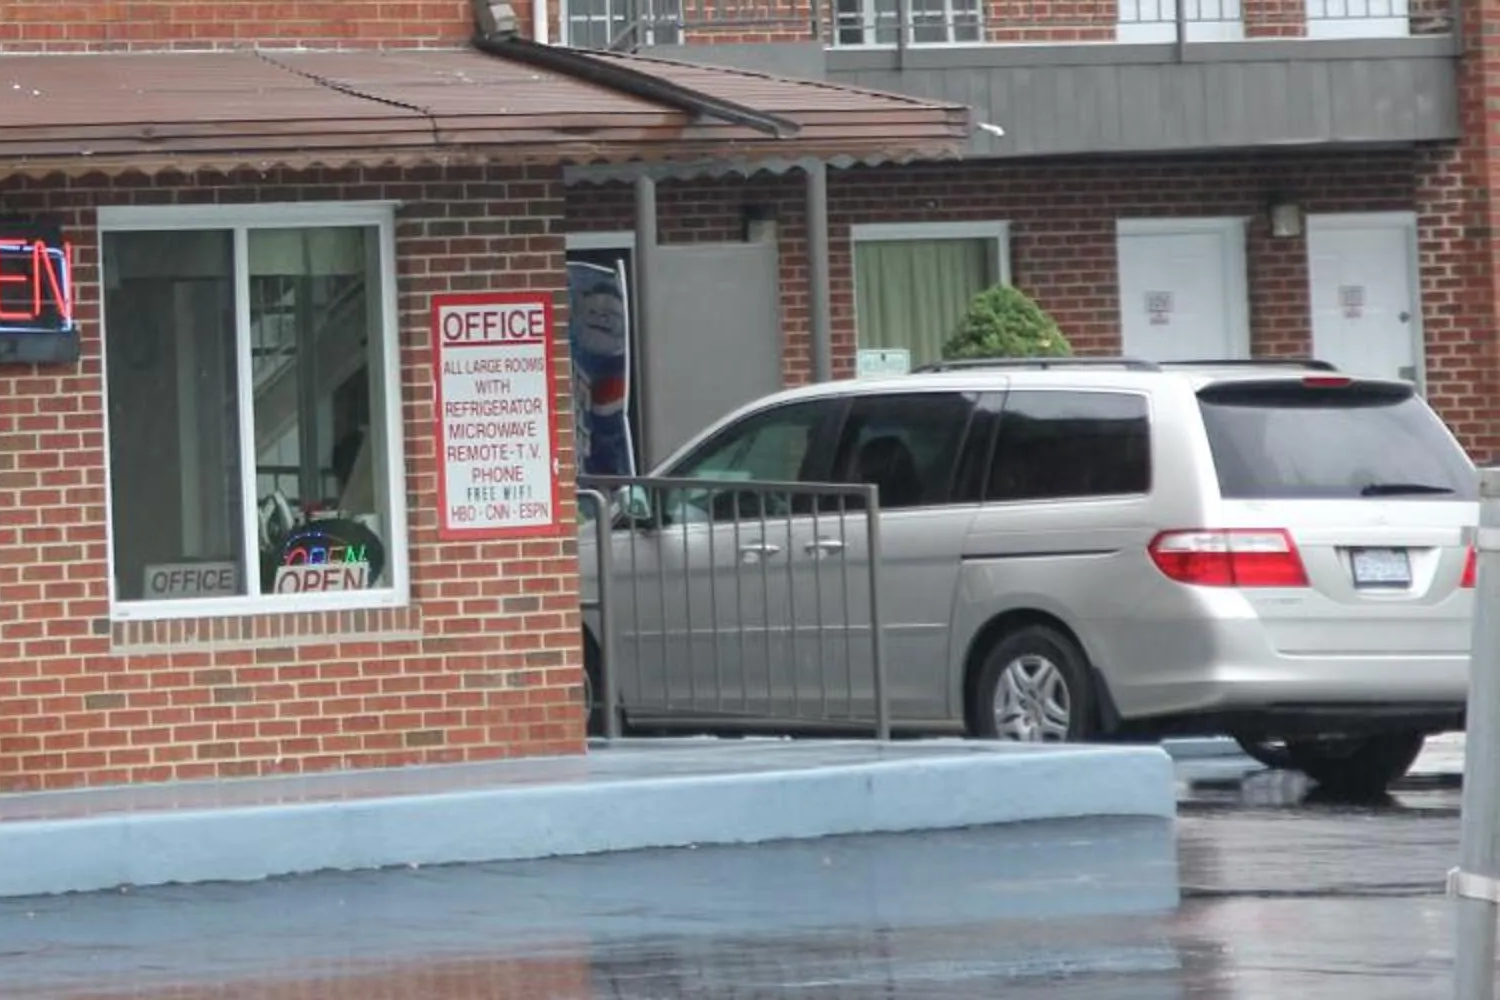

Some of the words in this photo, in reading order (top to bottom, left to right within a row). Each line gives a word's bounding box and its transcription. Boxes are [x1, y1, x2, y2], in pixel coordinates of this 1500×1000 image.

[443, 310, 543, 340] OFFICE
[443, 360, 463, 375] ALL
[465, 359, 502, 374] LARGE
[504, 357, 544, 373] ROOMS
[475, 379, 511, 394] WITH
[445, 398, 543, 418] REFRIGERATOR
[449, 421, 537, 440] MICROWAVE
[471, 465, 524, 483] PHONE
[467, 486, 496, 501] FREE
[503, 484, 532, 501] WIFI
[451, 504, 477, 521] HBO
[485, 503, 511, 521] CNN
[519, 502, 549, 519] ESPN
[152, 568, 233, 593] OFFICE
[278, 567, 364, 594] OPEN
